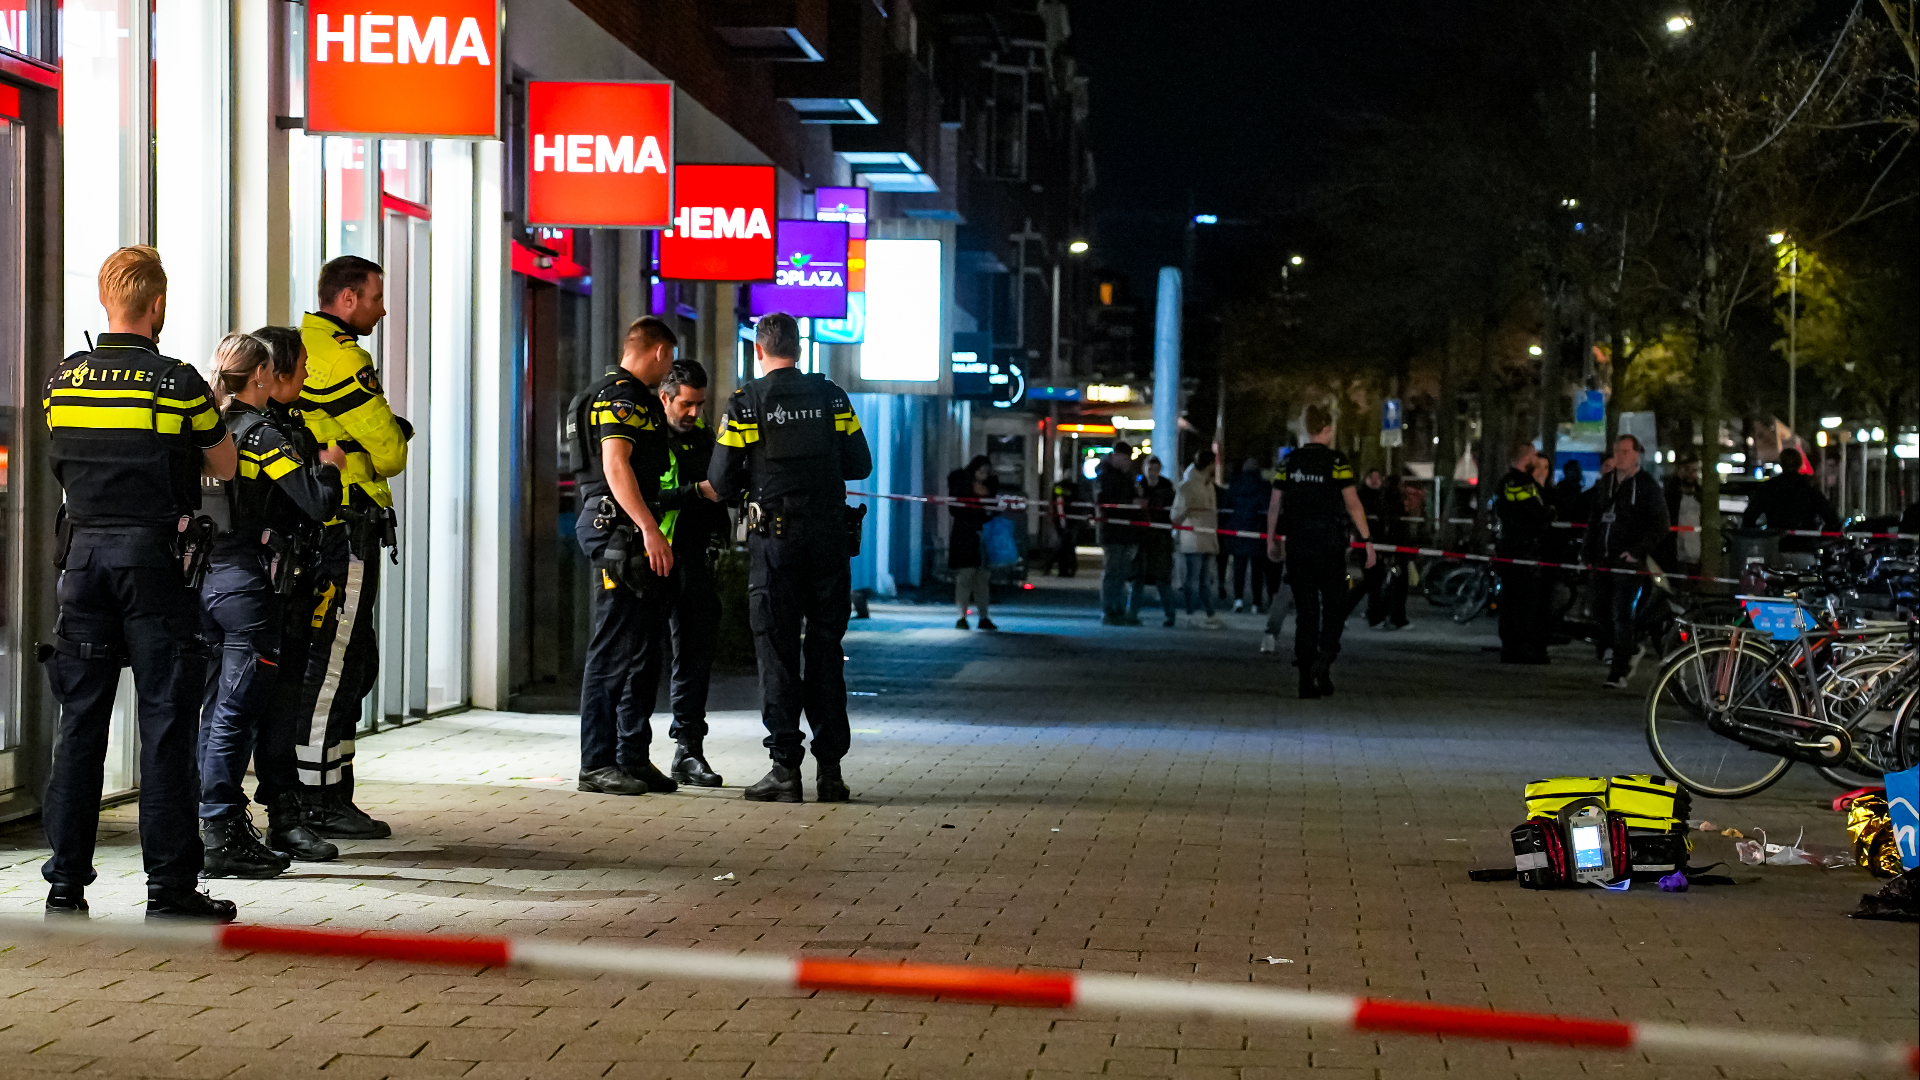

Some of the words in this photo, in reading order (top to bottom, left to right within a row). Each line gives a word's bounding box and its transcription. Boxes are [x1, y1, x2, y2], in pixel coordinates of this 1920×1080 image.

[316, 13, 491, 66] HEMA
[533, 135, 667, 174] HEMA
[664, 206, 771, 239] HEMA
[63, 362, 146, 387] POLITIE
[766, 405, 822, 424] POLITIE
